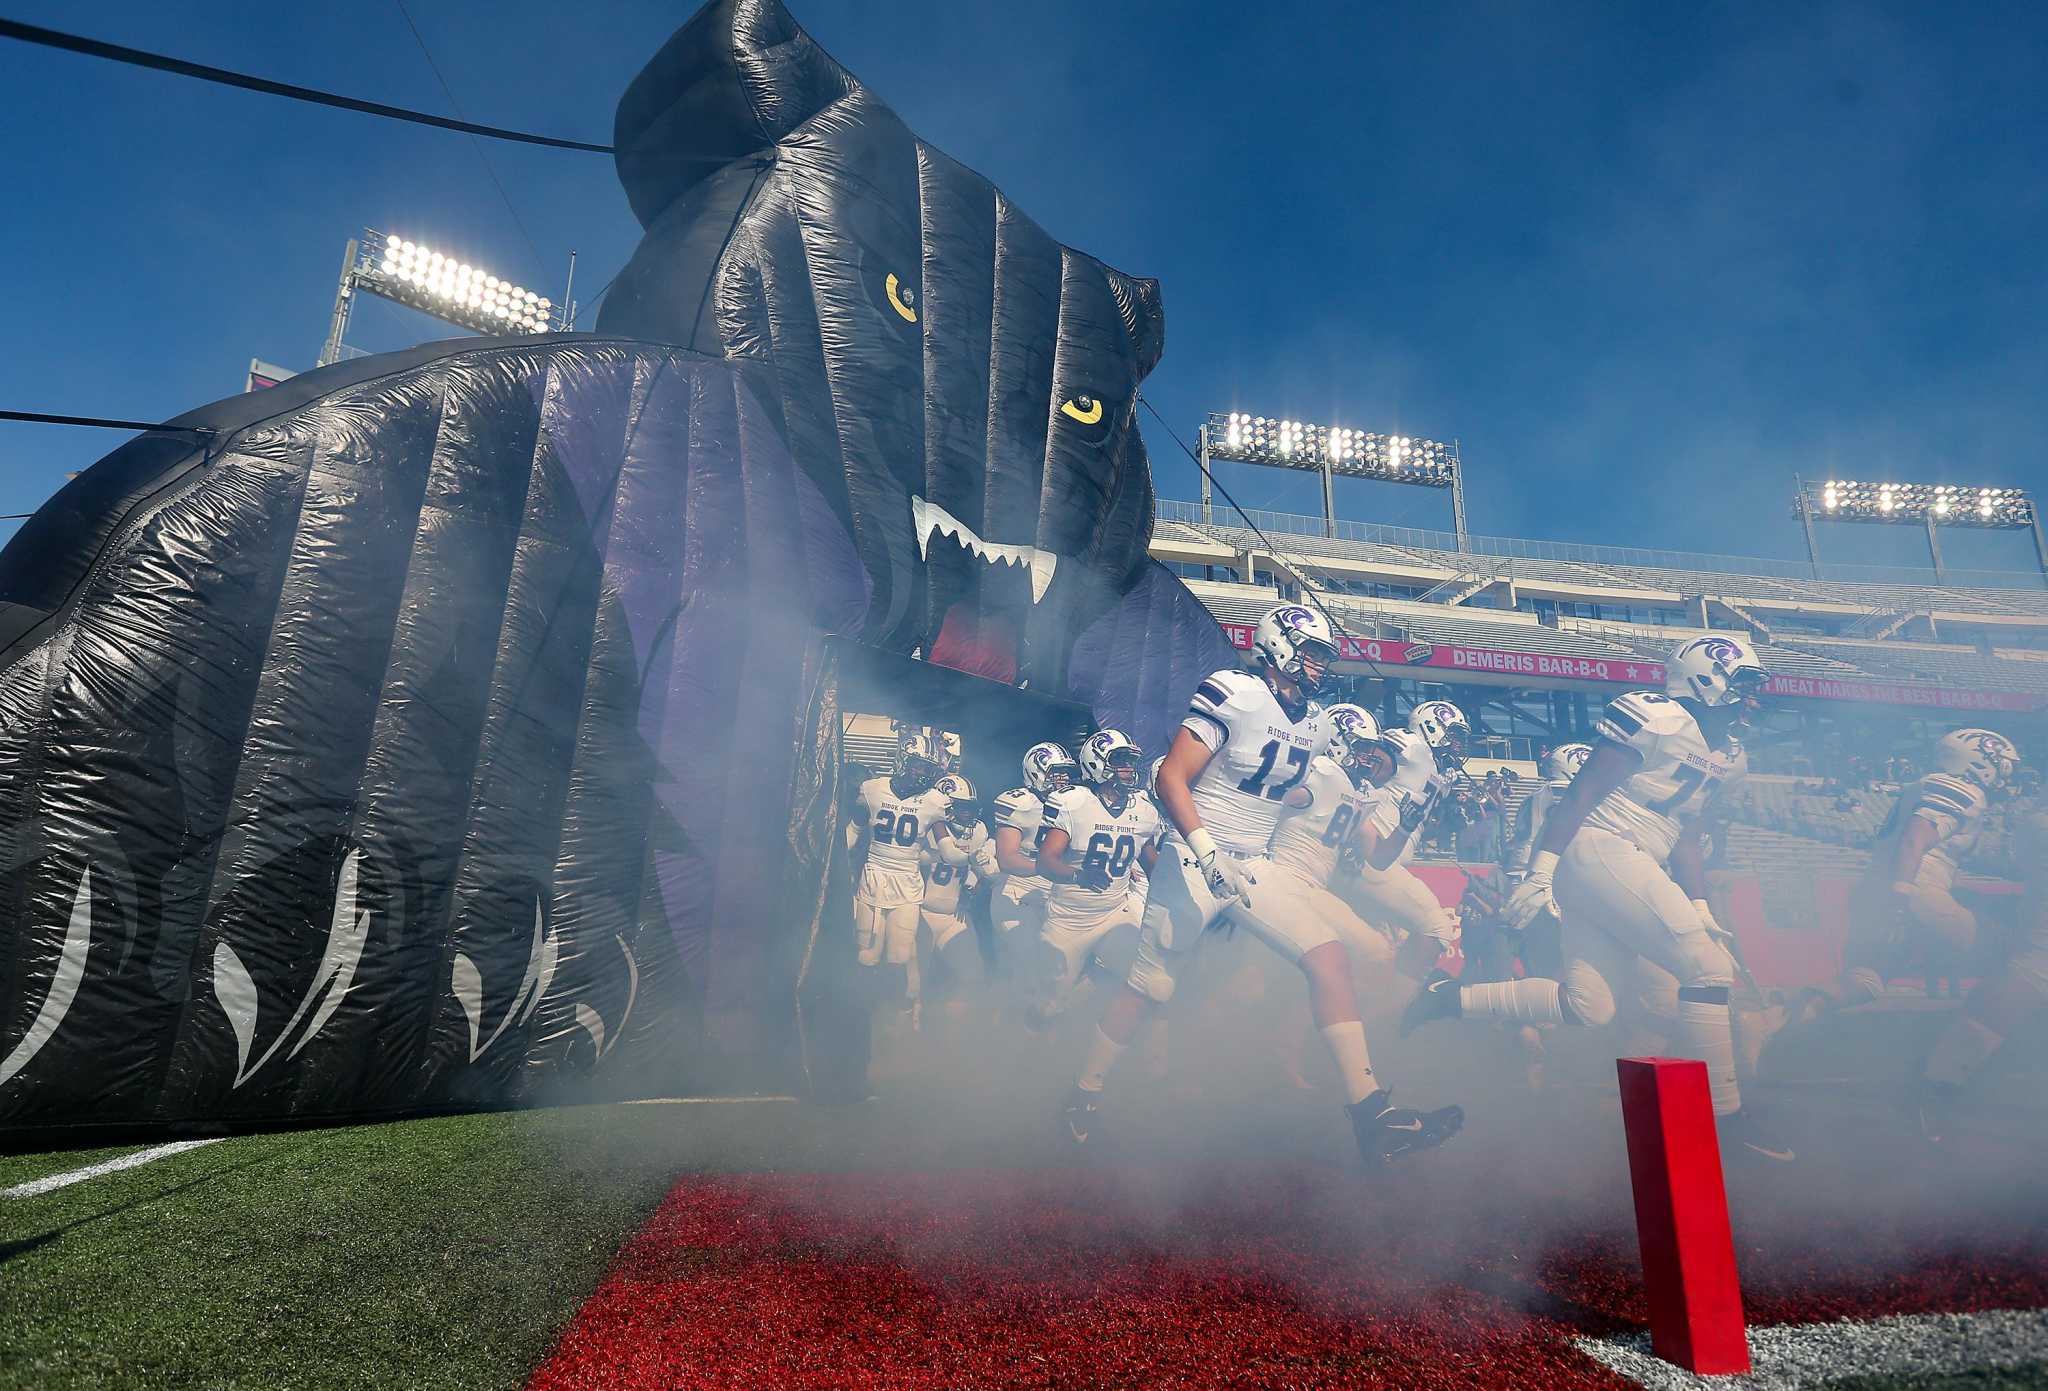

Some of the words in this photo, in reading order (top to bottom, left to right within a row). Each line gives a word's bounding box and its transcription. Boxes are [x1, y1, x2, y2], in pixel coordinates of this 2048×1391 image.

[1453, 649, 1534, 672] DEMERIS
[1539, 655, 1609, 680] BAR-B-Q
[1775, 678, 1815, 695] MEAT
[1267, 725, 1291, 742] RIDGE
[1294, 735, 1314, 749] POINT
[1237, 739, 1312, 801] 17
[881, 802, 899, 812] RIDGE
[874, 809, 919, 847] 20
[1094, 823, 1115, 832] RIDGE
[1116, 825, 1137, 834] POINT
[1082, 832, 1136, 878] 60
